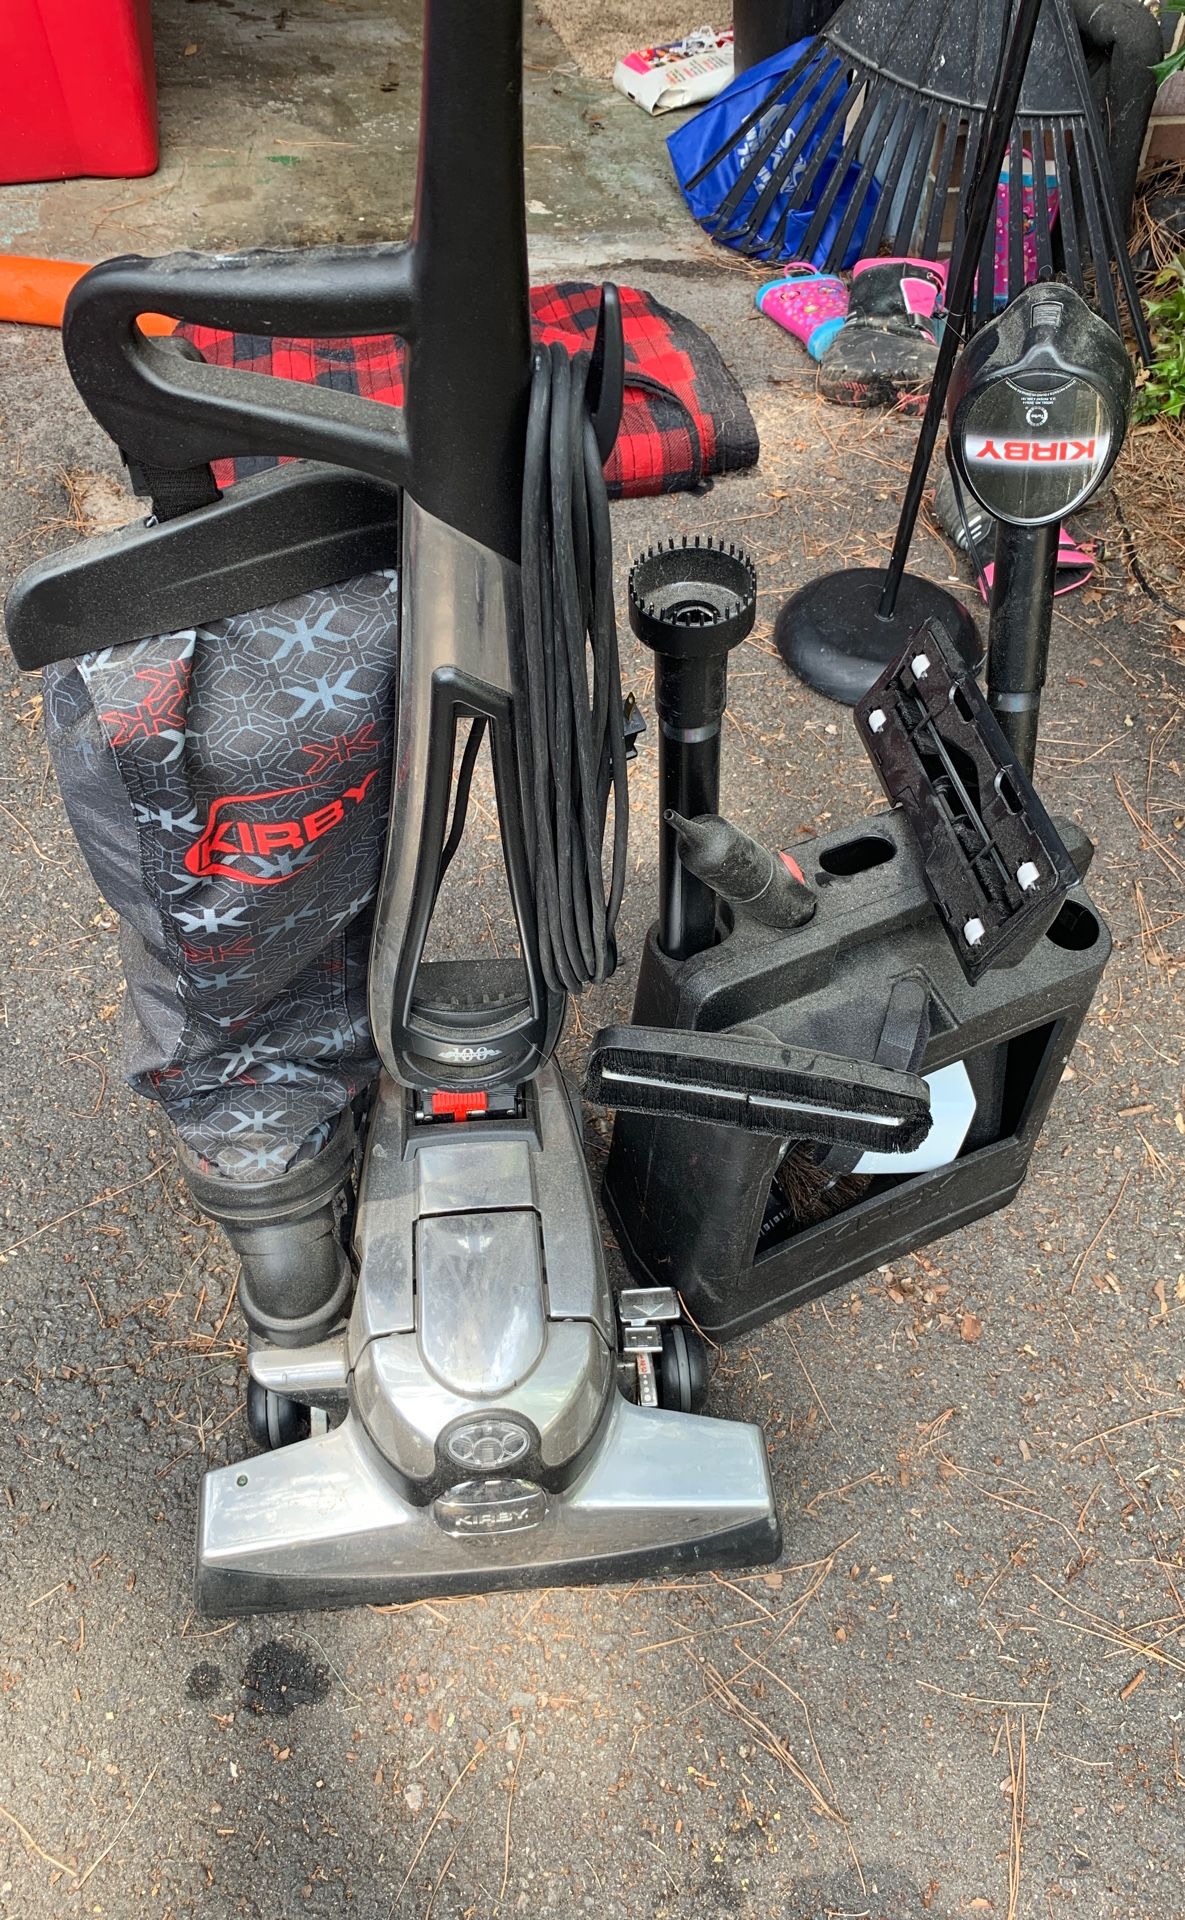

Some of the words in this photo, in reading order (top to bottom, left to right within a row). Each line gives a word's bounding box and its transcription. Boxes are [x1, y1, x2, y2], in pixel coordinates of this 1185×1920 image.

[976, 439, 1096, 462] KIRBY
[198, 768, 380, 871] KIRBY
[455, 1508, 529, 1526] KIRBY
